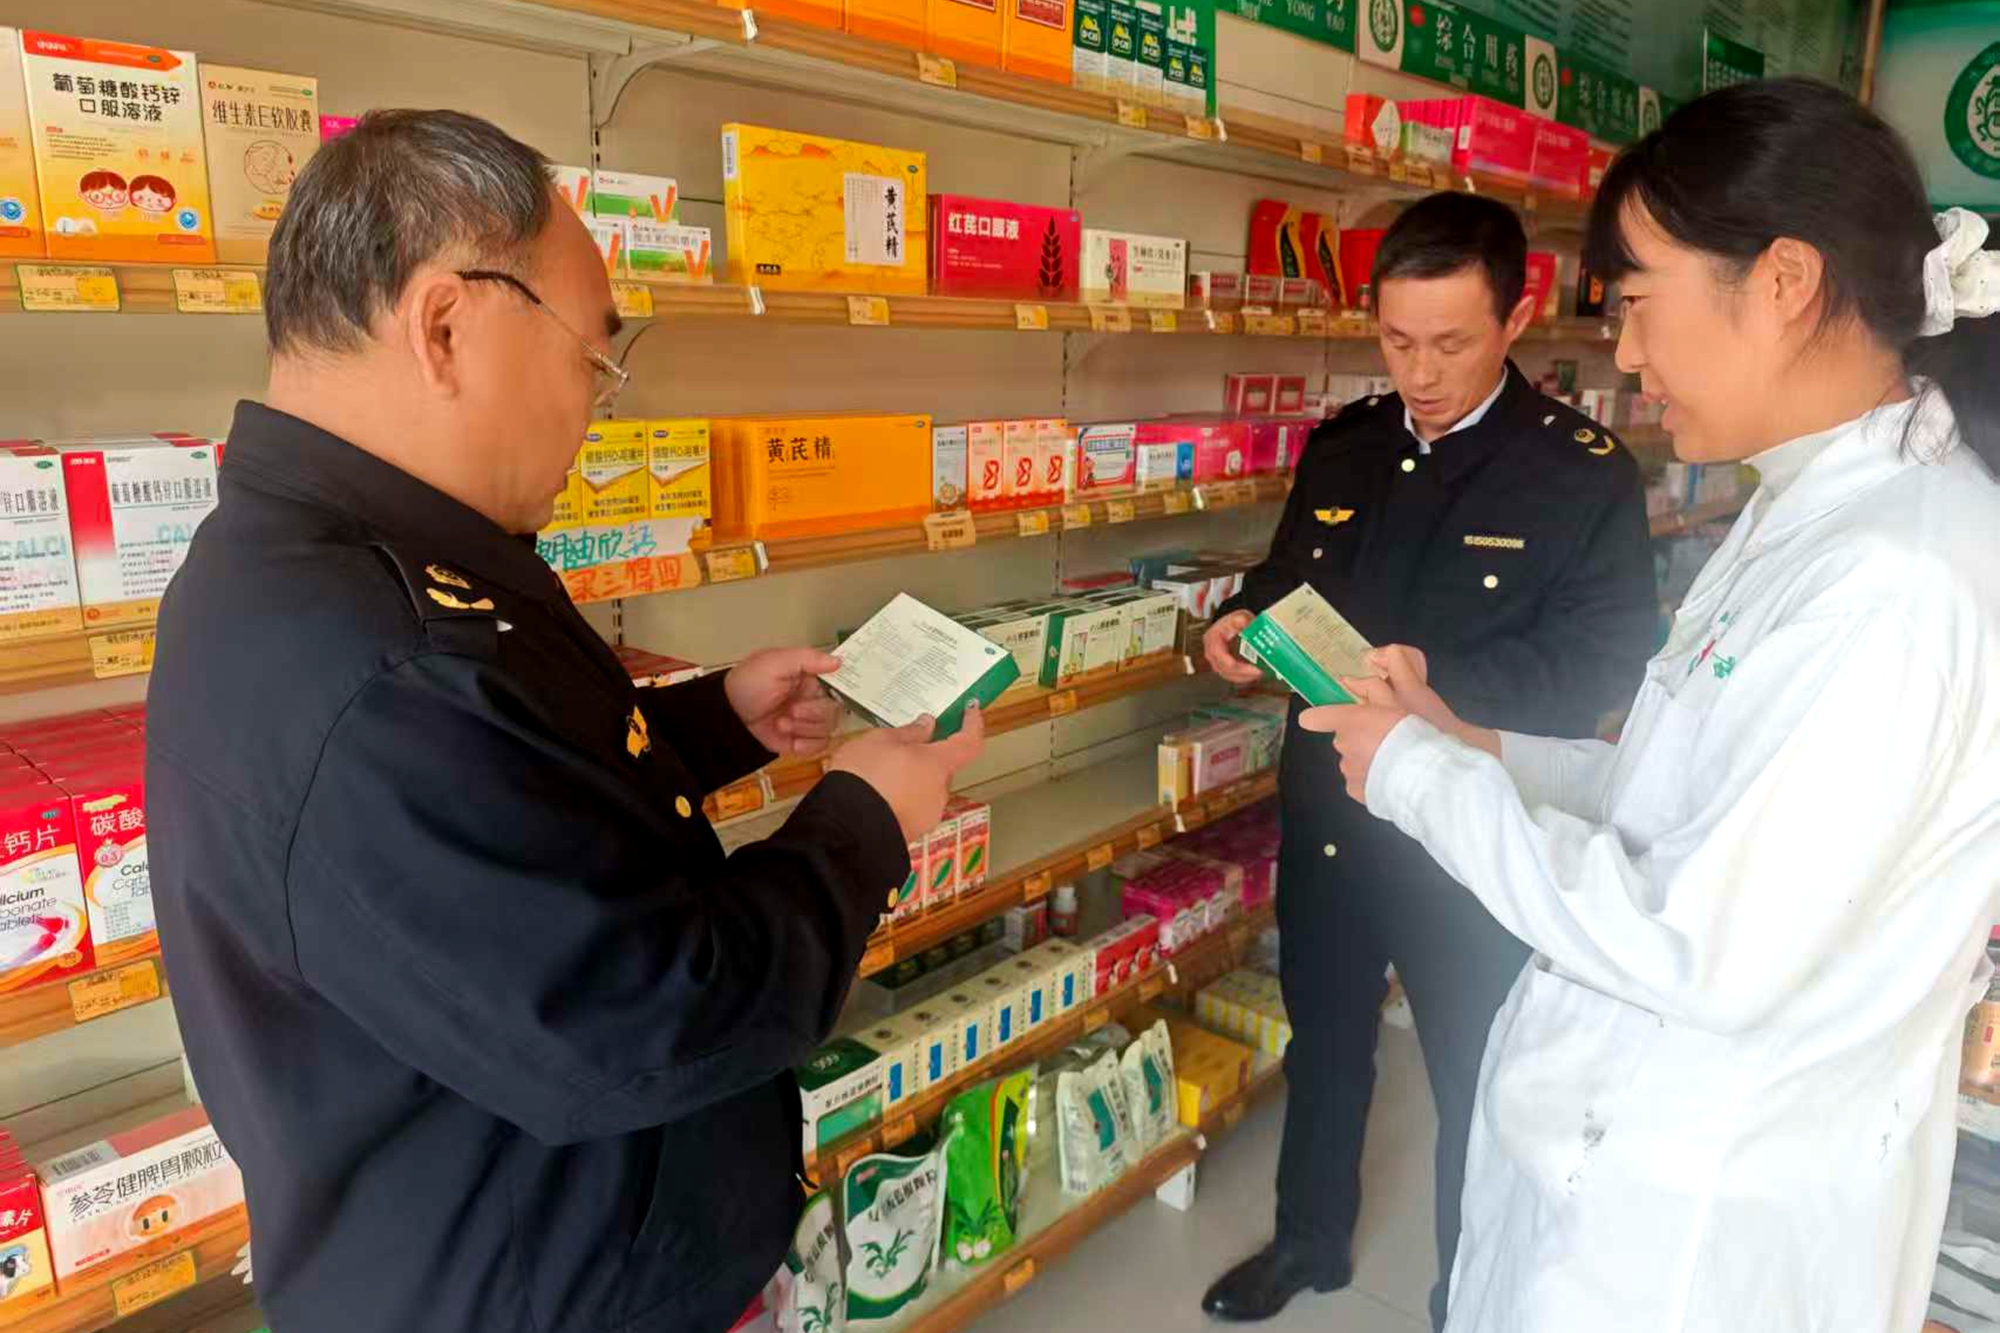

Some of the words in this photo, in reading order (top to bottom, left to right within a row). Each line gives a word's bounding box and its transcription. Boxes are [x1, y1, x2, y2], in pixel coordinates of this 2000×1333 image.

[52, 72, 181, 105] 葡萄糖酸钙锌
[79, 99, 163, 123] 口服溶液
[212, 100, 314, 132] 维生素E软胶囊
[884, 186, 900, 258] 黄芪精
[768, 436, 832, 463] 黄芪精
[0, 888, 44, 905] lcium
[70, 1140, 224, 1218] 参苓健脾胃颗粒
